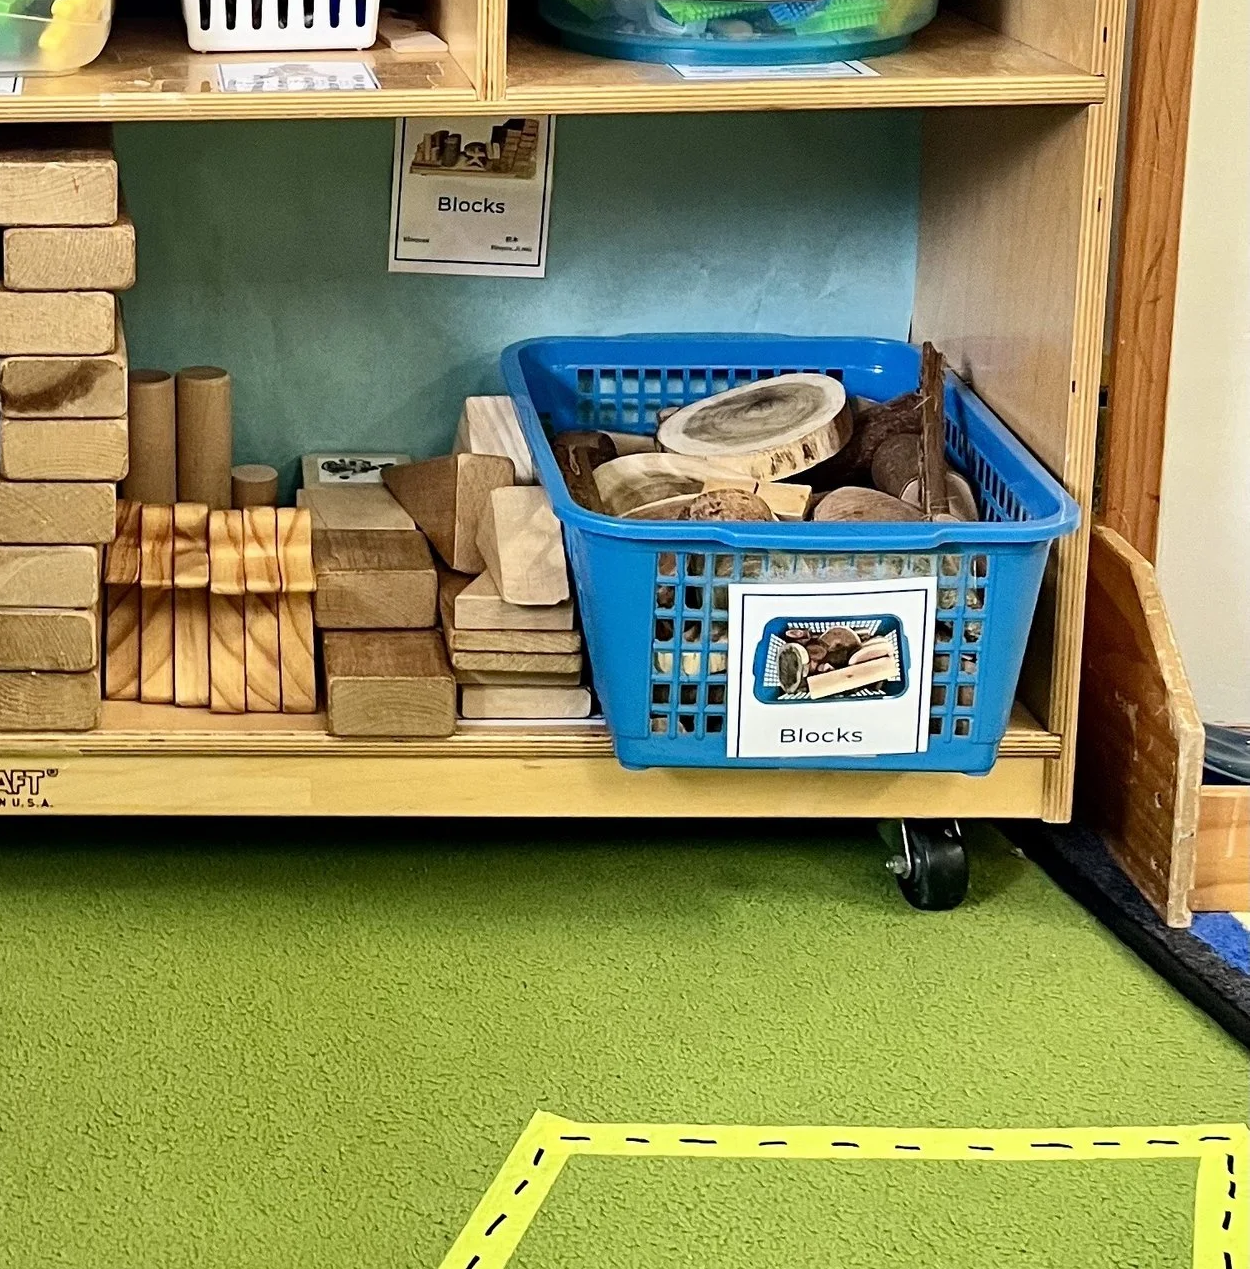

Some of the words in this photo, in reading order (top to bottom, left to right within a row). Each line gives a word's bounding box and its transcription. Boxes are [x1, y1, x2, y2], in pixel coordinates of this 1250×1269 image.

[438, 196, 505, 214] Blocks
[780, 727, 863, 743] Blocks
[12, 797, 54, 808] U.S.A.
